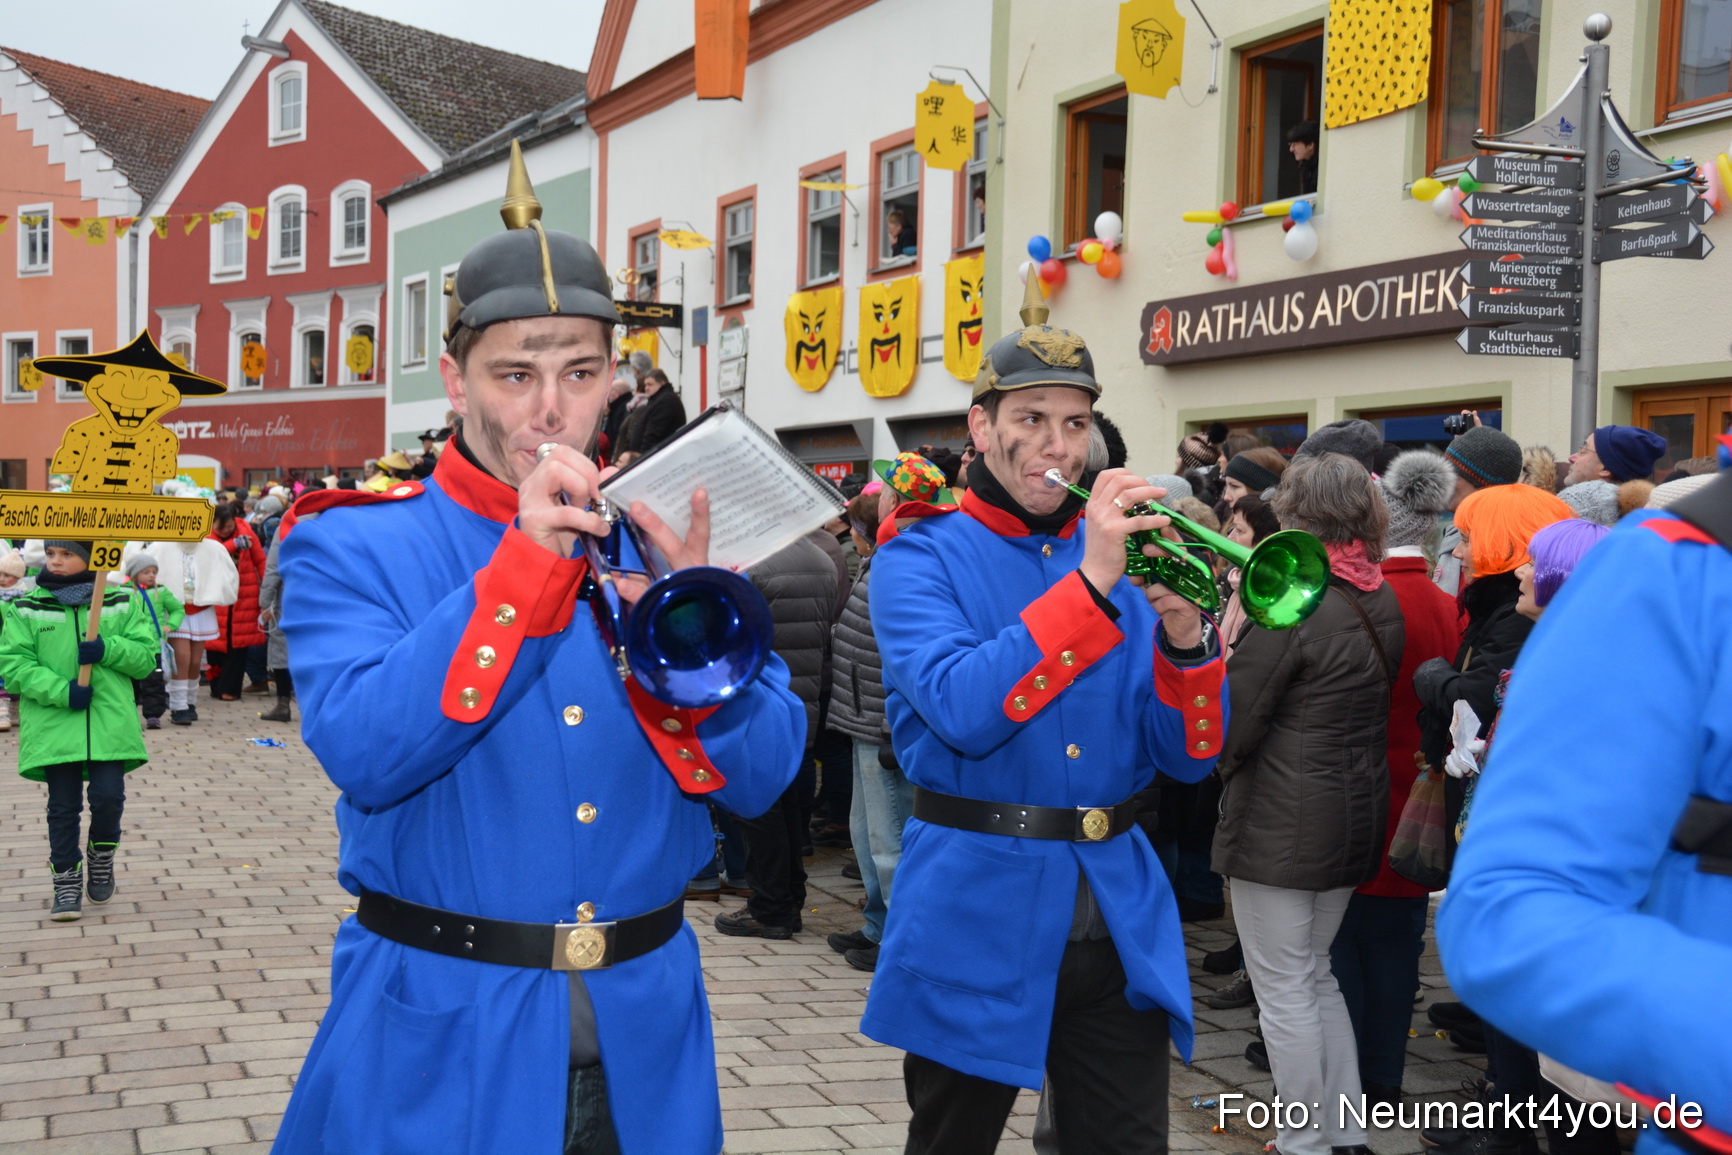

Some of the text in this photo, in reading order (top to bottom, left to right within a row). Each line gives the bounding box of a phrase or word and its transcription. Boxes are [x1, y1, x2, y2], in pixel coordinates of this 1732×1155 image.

[1494, 158, 1558, 173] Museum im
[1496, 171, 1555, 186] Hollerhaus
[1477, 198, 1571, 217] Wassertretanlage
[1618, 197, 1671, 219] Keltenhaus
[1477, 227, 1567, 242] Meditationshaus
[1621, 230, 1678, 252] Barfußpark
[1472, 239, 1571, 255] Franziskanerkloster
[1489, 261, 1562, 276] Mariengrotte
[1501, 274, 1557, 290] Kreuzberg
[1176, 291, 1305, 348] RATHAUS
[1308, 266, 1475, 330] APOTHEK
[1478, 301, 1565, 319] Franziskuspark
[1488, 330, 1554, 343] Kulturhaus
[1480, 342, 1562, 355] Stadtbücherei
[0, 503, 203, 535] FaschG. Grün-Weiß Zwiebelonia Beilngries
[93, 547, 121, 568] 39
